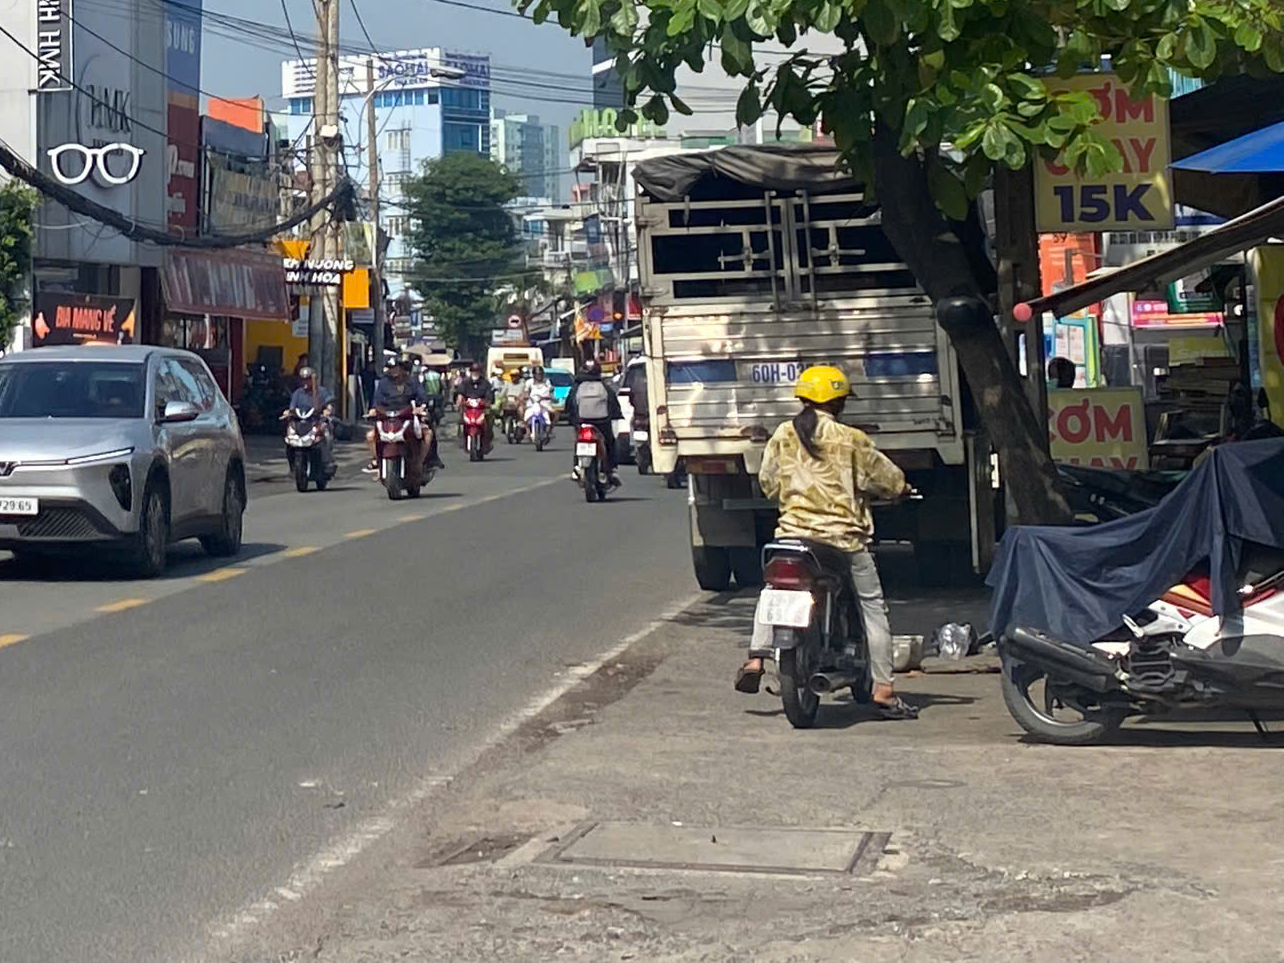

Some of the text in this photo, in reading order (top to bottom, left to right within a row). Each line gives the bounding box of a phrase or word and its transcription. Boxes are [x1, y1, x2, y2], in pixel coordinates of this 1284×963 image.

[38, 30, 60, 87] HMK
[1054, 184, 1155, 223] 15K
[56, 305, 71, 328] BIA
